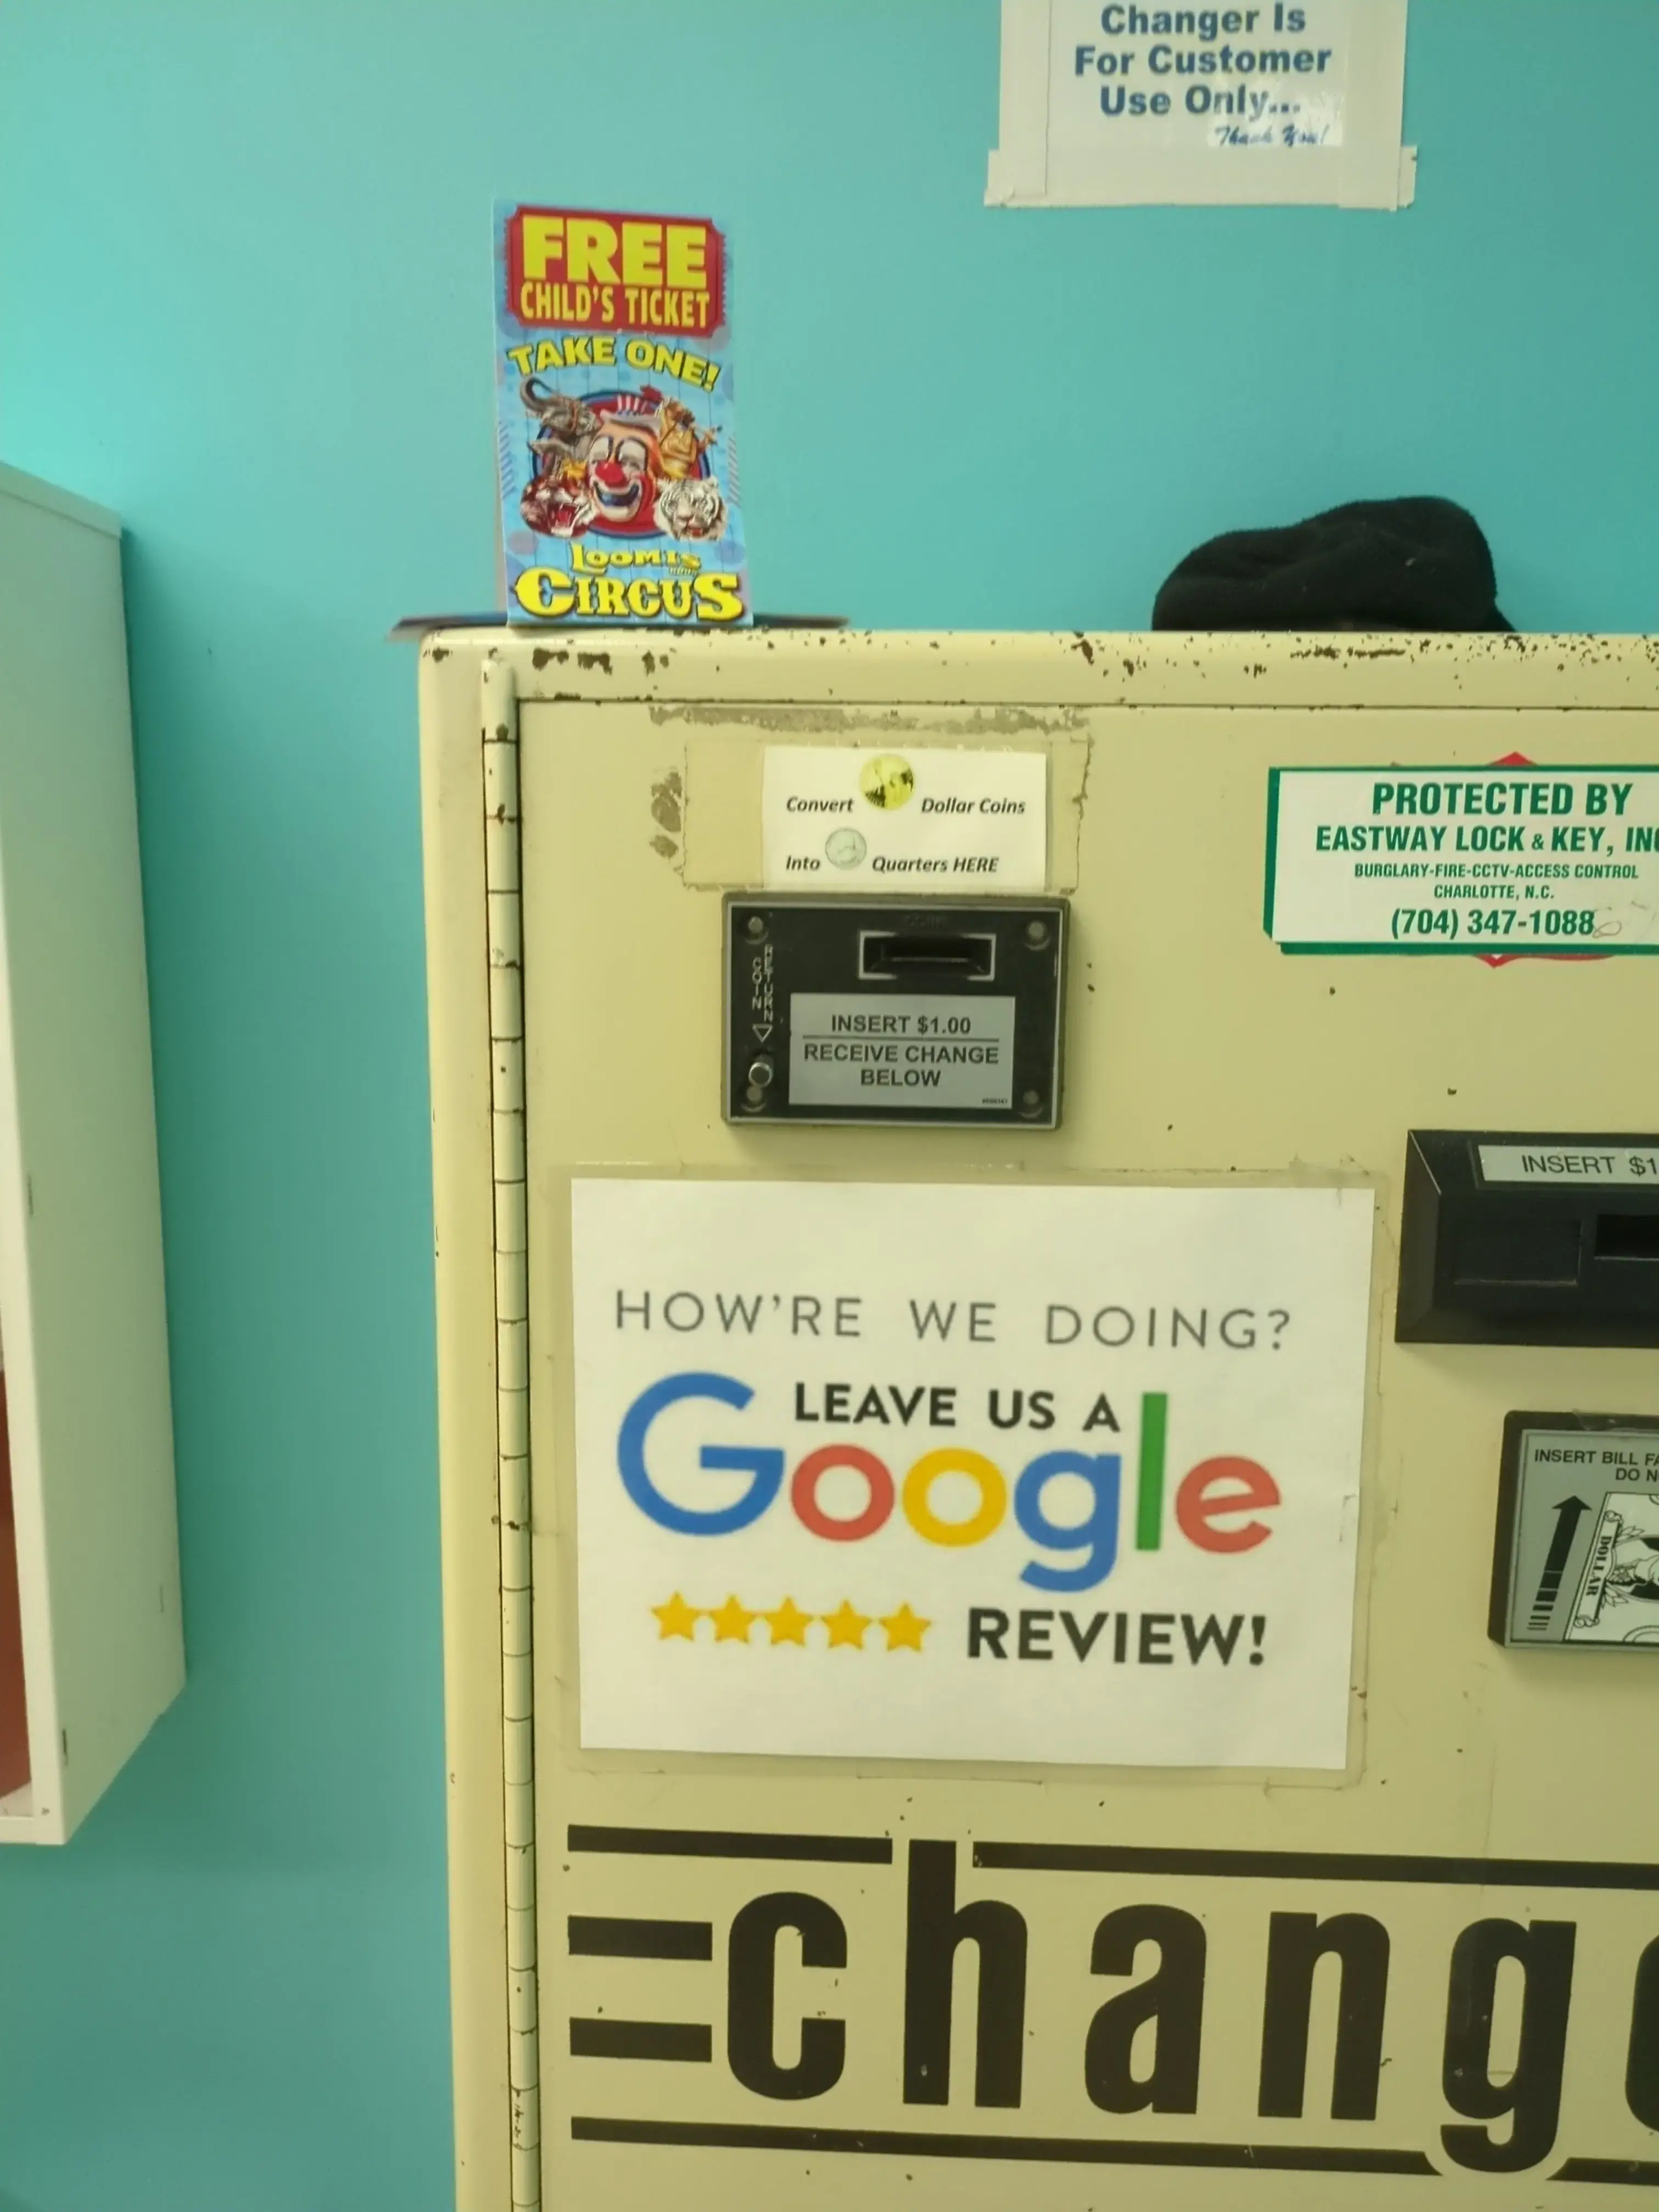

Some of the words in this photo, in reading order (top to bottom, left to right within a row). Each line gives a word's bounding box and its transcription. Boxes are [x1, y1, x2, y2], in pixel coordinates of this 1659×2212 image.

[1101, 3, 1260, 41] Changer
[1274, 3, 1306, 32] Is
[1075, 45, 1135, 76] For
[1148, 44, 1332, 75] Customer
[1100, 86, 1171, 117] Use
[1185, 84, 1302, 121] Only...
[523, 216, 707, 289] FREE
[520, 280, 614, 323] CHILD'S
[624, 288, 710, 328] TICKET
[507, 336, 616, 375] TAKE
[625, 340, 720, 392] ONE!
[515, 567, 744, 620] CIRCUS
[786, 796, 853, 813] Convert
[921, 797, 975, 814] Dollar
[979, 798, 1026, 814] Coins
[1373, 782, 1573, 815] PROTECTED
[1585, 783, 1633, 815] BY
[1316, 826, 1446, 851] EASTWAY
[1455, 826, 1525, 851] LOCK
[1532, 834, 1544, 850] &
[1551, 827, 1614, 857] KEY,
[1626, 827, 1659, 851] IN
[786, 856, 821, 871] Into
[872, 857, 947, 873] Quarters
[952, 857, 1000, 873] HERE
[1354, 864, 1570, 878] BURGLARY-FIRE-CCTV-ACCESS
[1575, 865, 1639, 879] CONTROL
[1434, 885, 1520, 901] CHARLOTTE,
[1525, 886, 1554, 899] N.C.
[1391, 909, 1459, 940] (704)
[1467, 910, 1594, 935] 347-1088
[832, 1015, 910, 1034] INSERT
[918, 1017, 971, 1035] $1.00
[804, 1044, 898, 1062] RECEIVE
[905, 1046, 999, 1063] CHANGE
[861, 1069, 941, 1087] BELOW
[1522, 1155, 1615, 1173] INSERT
[616, 1289, 862, 1337] HOW'RE
[909, 1299, 996, 1342] WE
[1045, 1304, 1291, 1350] DOING?
[793, 1383, 957, 1427] LEAVE
[988, 1390, 1056, 1430] US
[1082, 1393, 1121, 1432] A
[1534, 1449, 1596, 1463] INSERT
[1601, 1451, 1638, 1465] BILL
[617, 1372, 1282, 1593] Google
[1615, 1468, 1640, 1481] DO
[1585, 1536, 1611, 1596] DOLLAR
[967, 1607, 1267, 1666] REVIEW!
[727, 1839, 1659, 2174] chang
